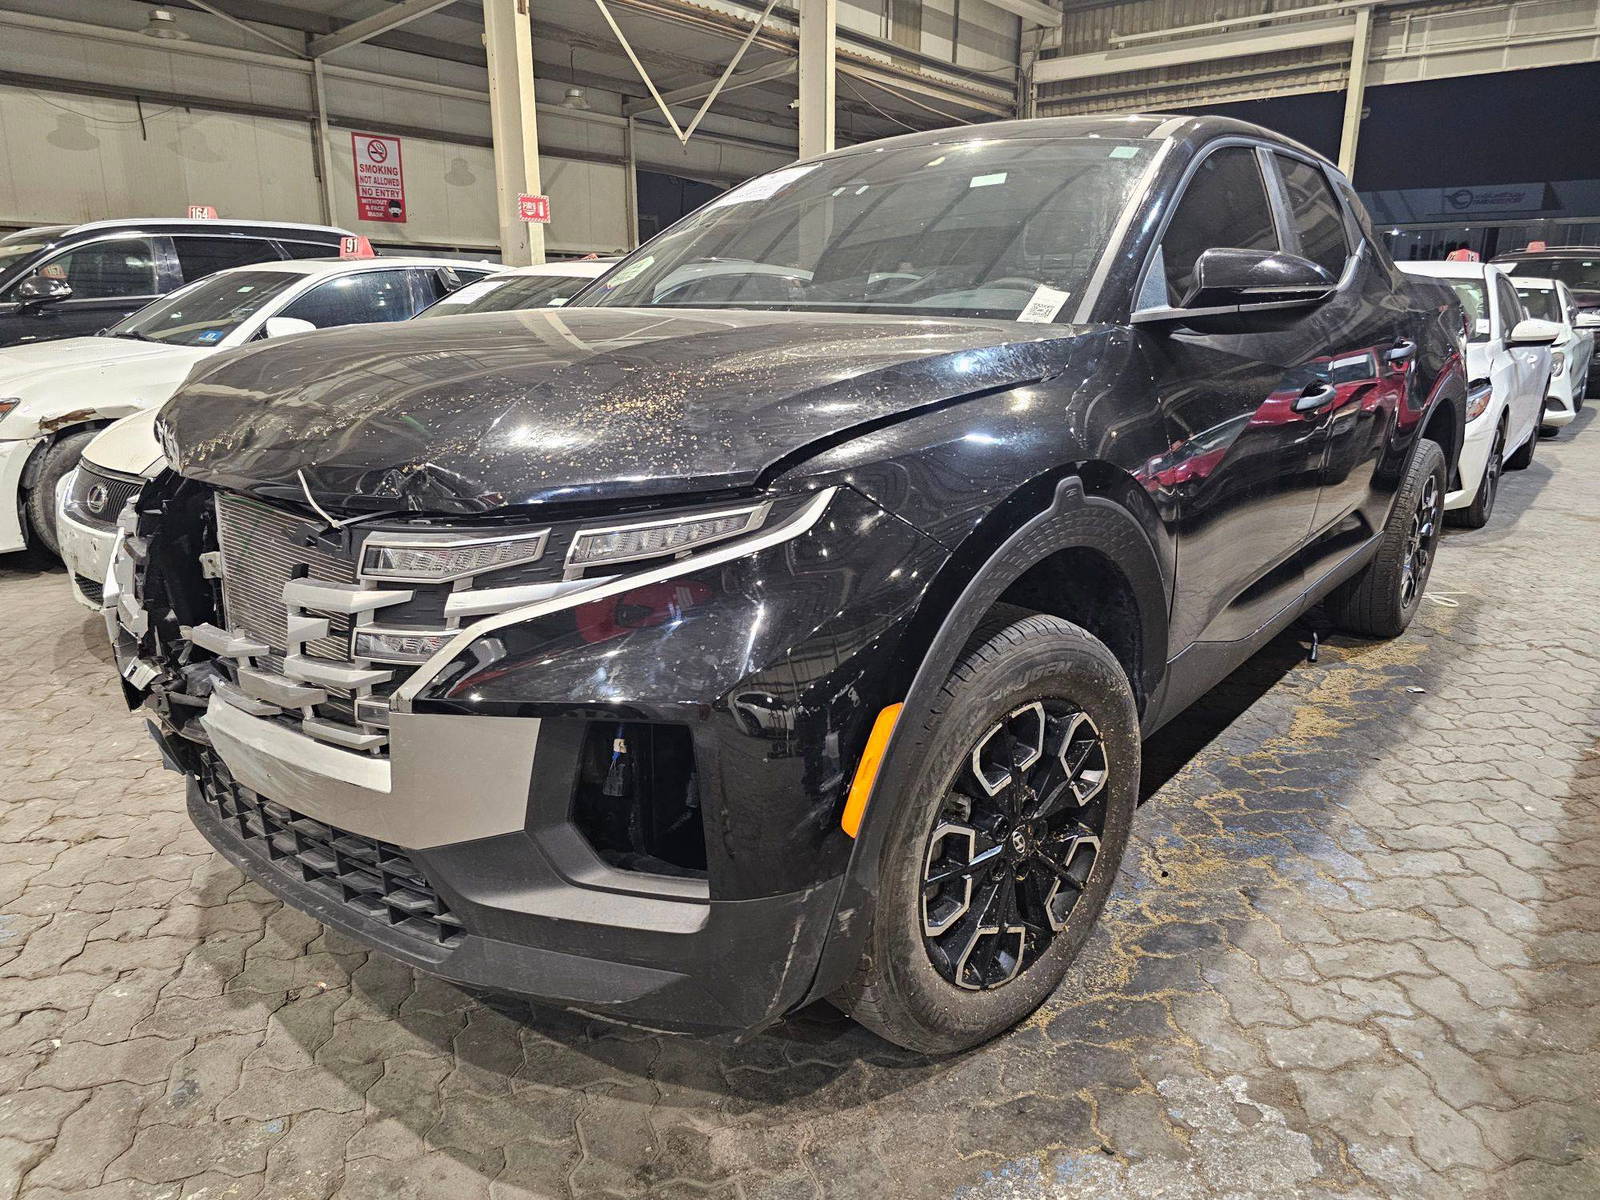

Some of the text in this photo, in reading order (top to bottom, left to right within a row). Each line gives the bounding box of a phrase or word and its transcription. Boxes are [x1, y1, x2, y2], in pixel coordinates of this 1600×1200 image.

[359, 163, 399, 176] SMOKING
[359, 175, 400, 187] NOT ALLOWED
[361, 187, 400, 198] NO ENTRY
[191, 207, 208, 220] 164
[346, 238, 358, 253] 91
